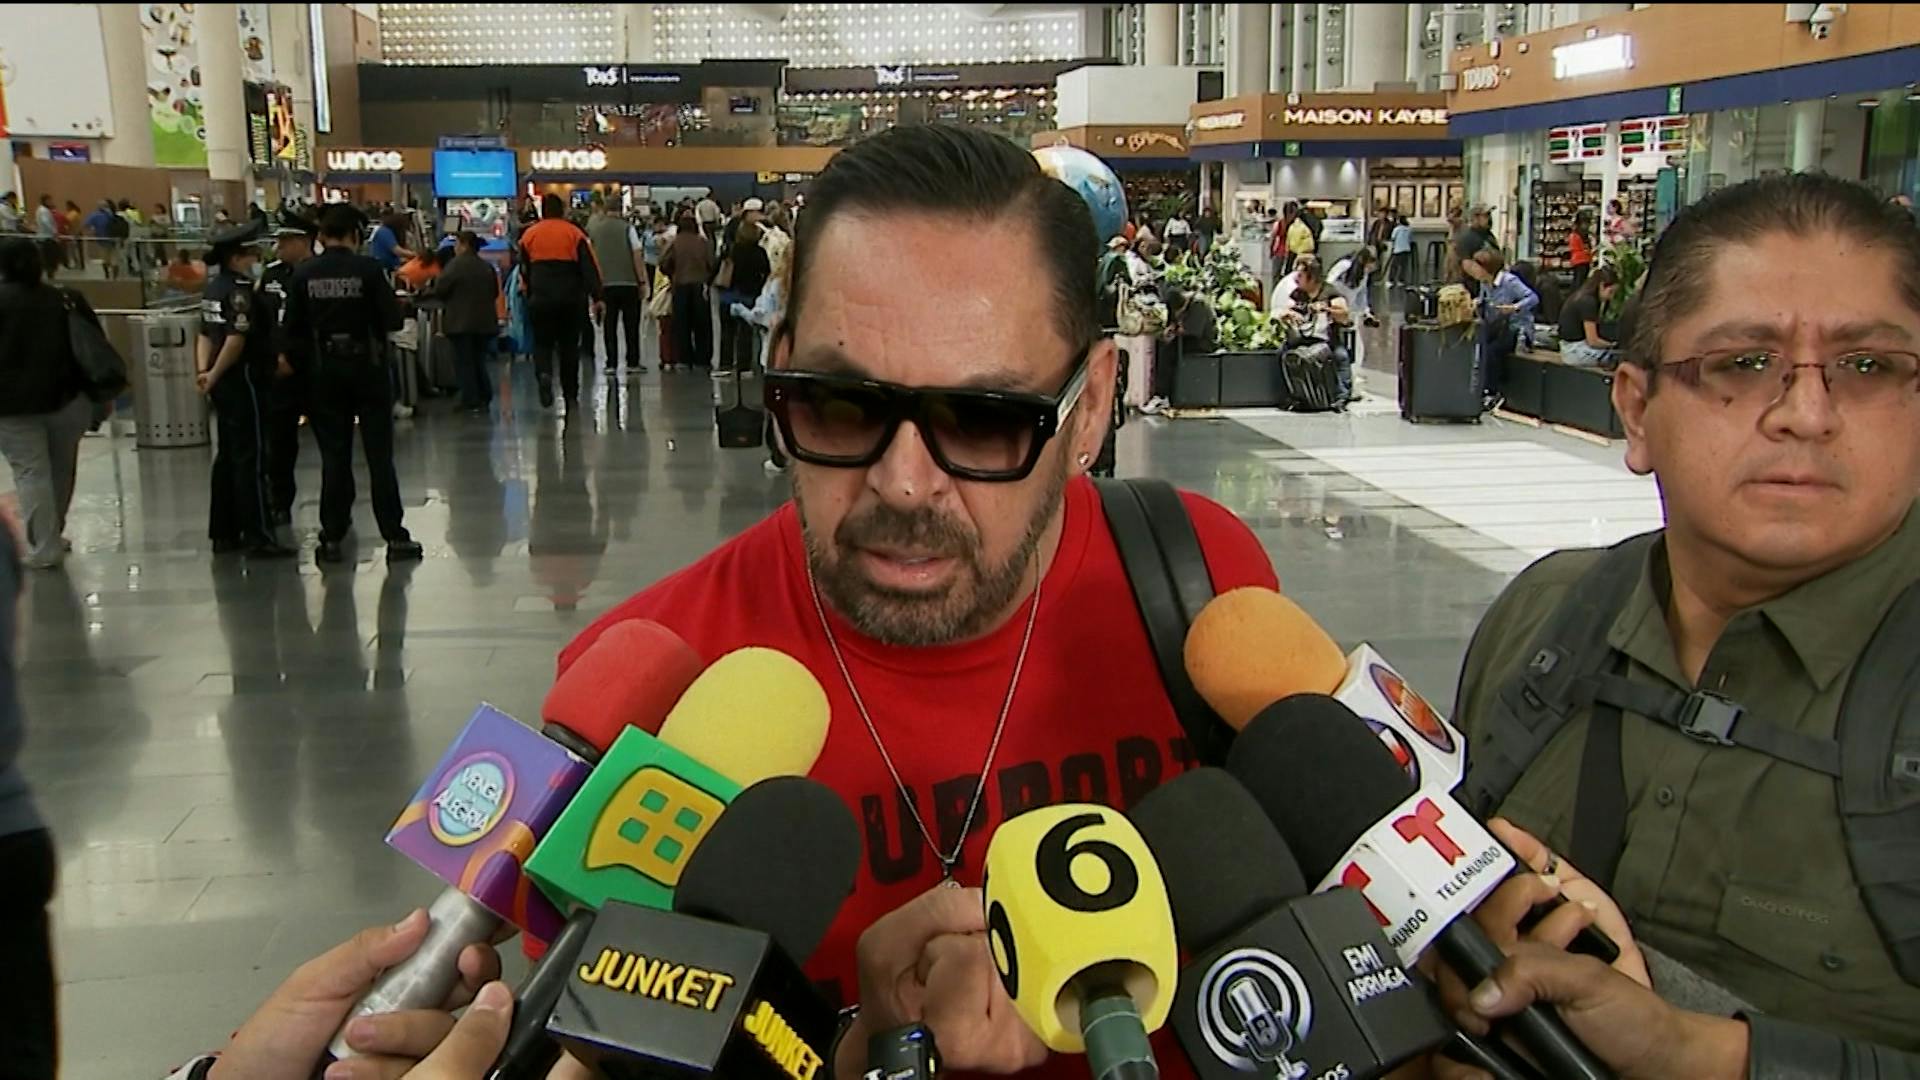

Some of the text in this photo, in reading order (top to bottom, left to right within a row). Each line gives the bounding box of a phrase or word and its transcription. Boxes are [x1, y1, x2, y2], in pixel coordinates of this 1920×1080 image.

[1284, 109, 1449, 125] MAISON KAYSE
[1035, 813, 1139, 912] 6
[1436, 846, 1502, 900] TELEMUNDO
[579, 948, 734, 1011] JUNKET
[1342, 943, 1385, 974] EMI
[744, 1000, 824, 1080] JUNKET
